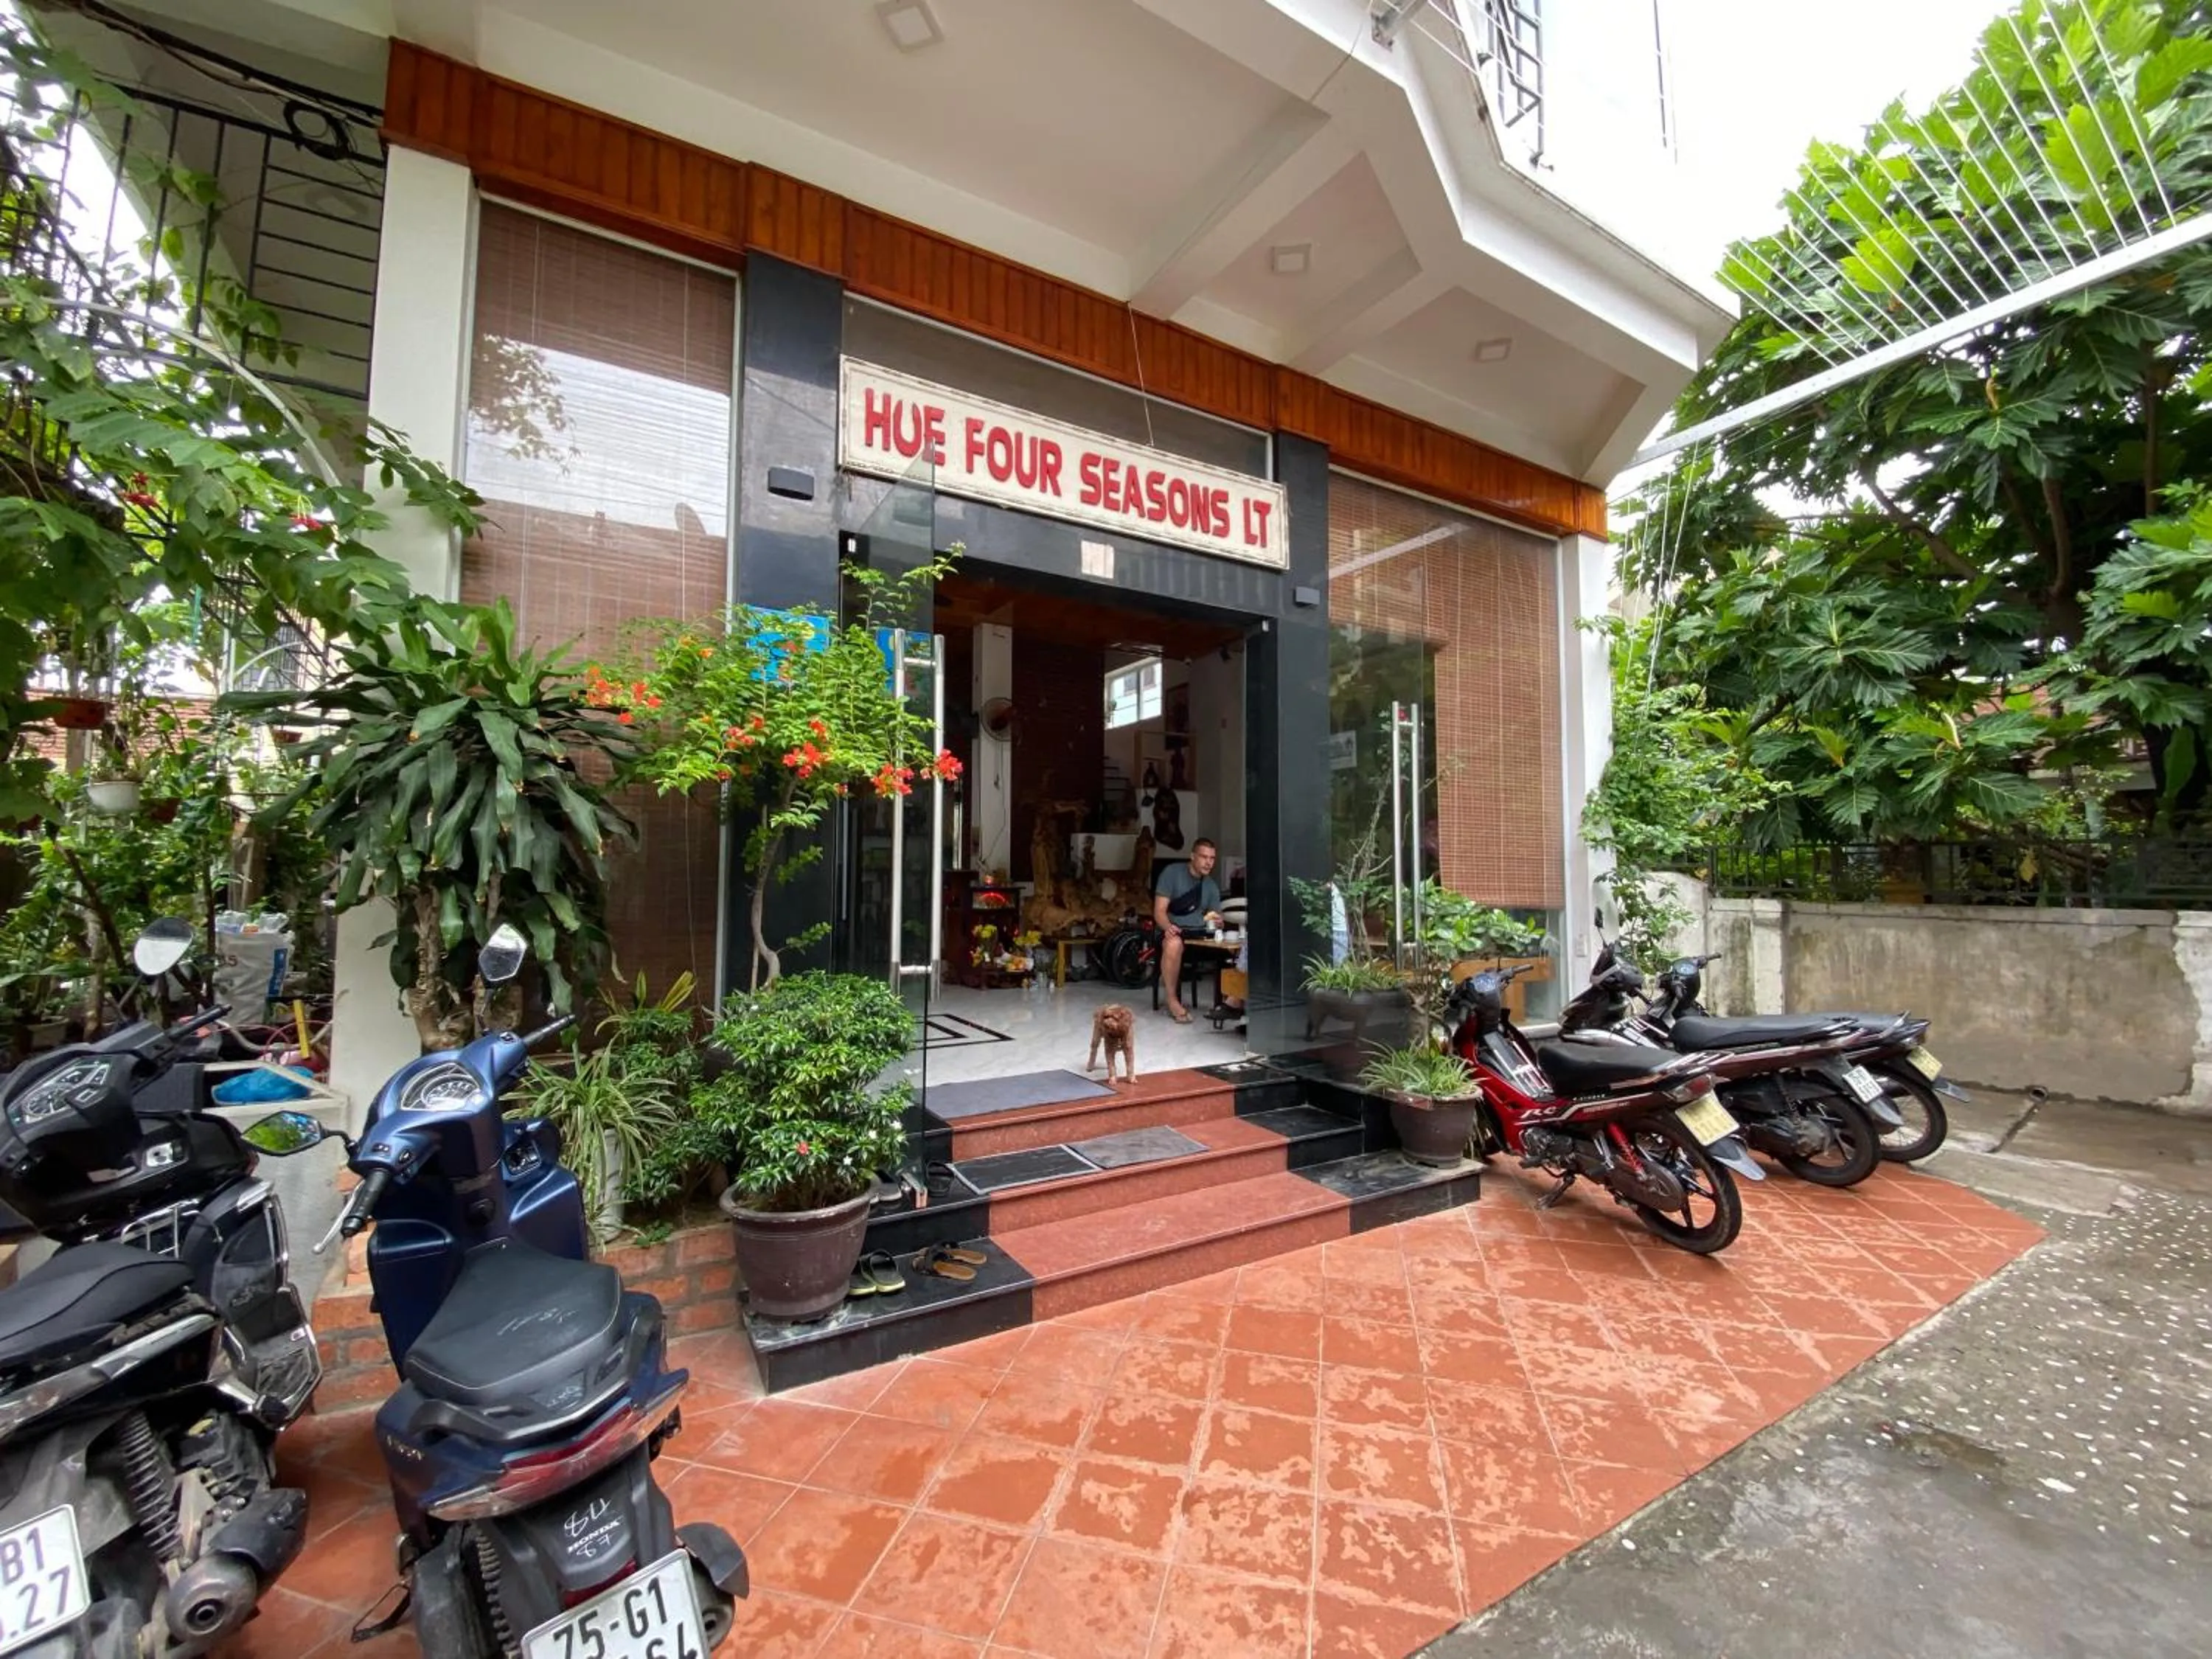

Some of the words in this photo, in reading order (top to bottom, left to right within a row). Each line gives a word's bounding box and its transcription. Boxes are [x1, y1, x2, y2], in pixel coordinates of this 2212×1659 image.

[864, 387, 946, 467] HUE
[964, 416, 1063, 498] FOUR
[1079, 451, 1231, 538] SEASONS
[1242, 497, 1273, 549] LT
[567, 1519, 621, 1554] HONDA
[553, 1576, 668, 1659] 75-G1
